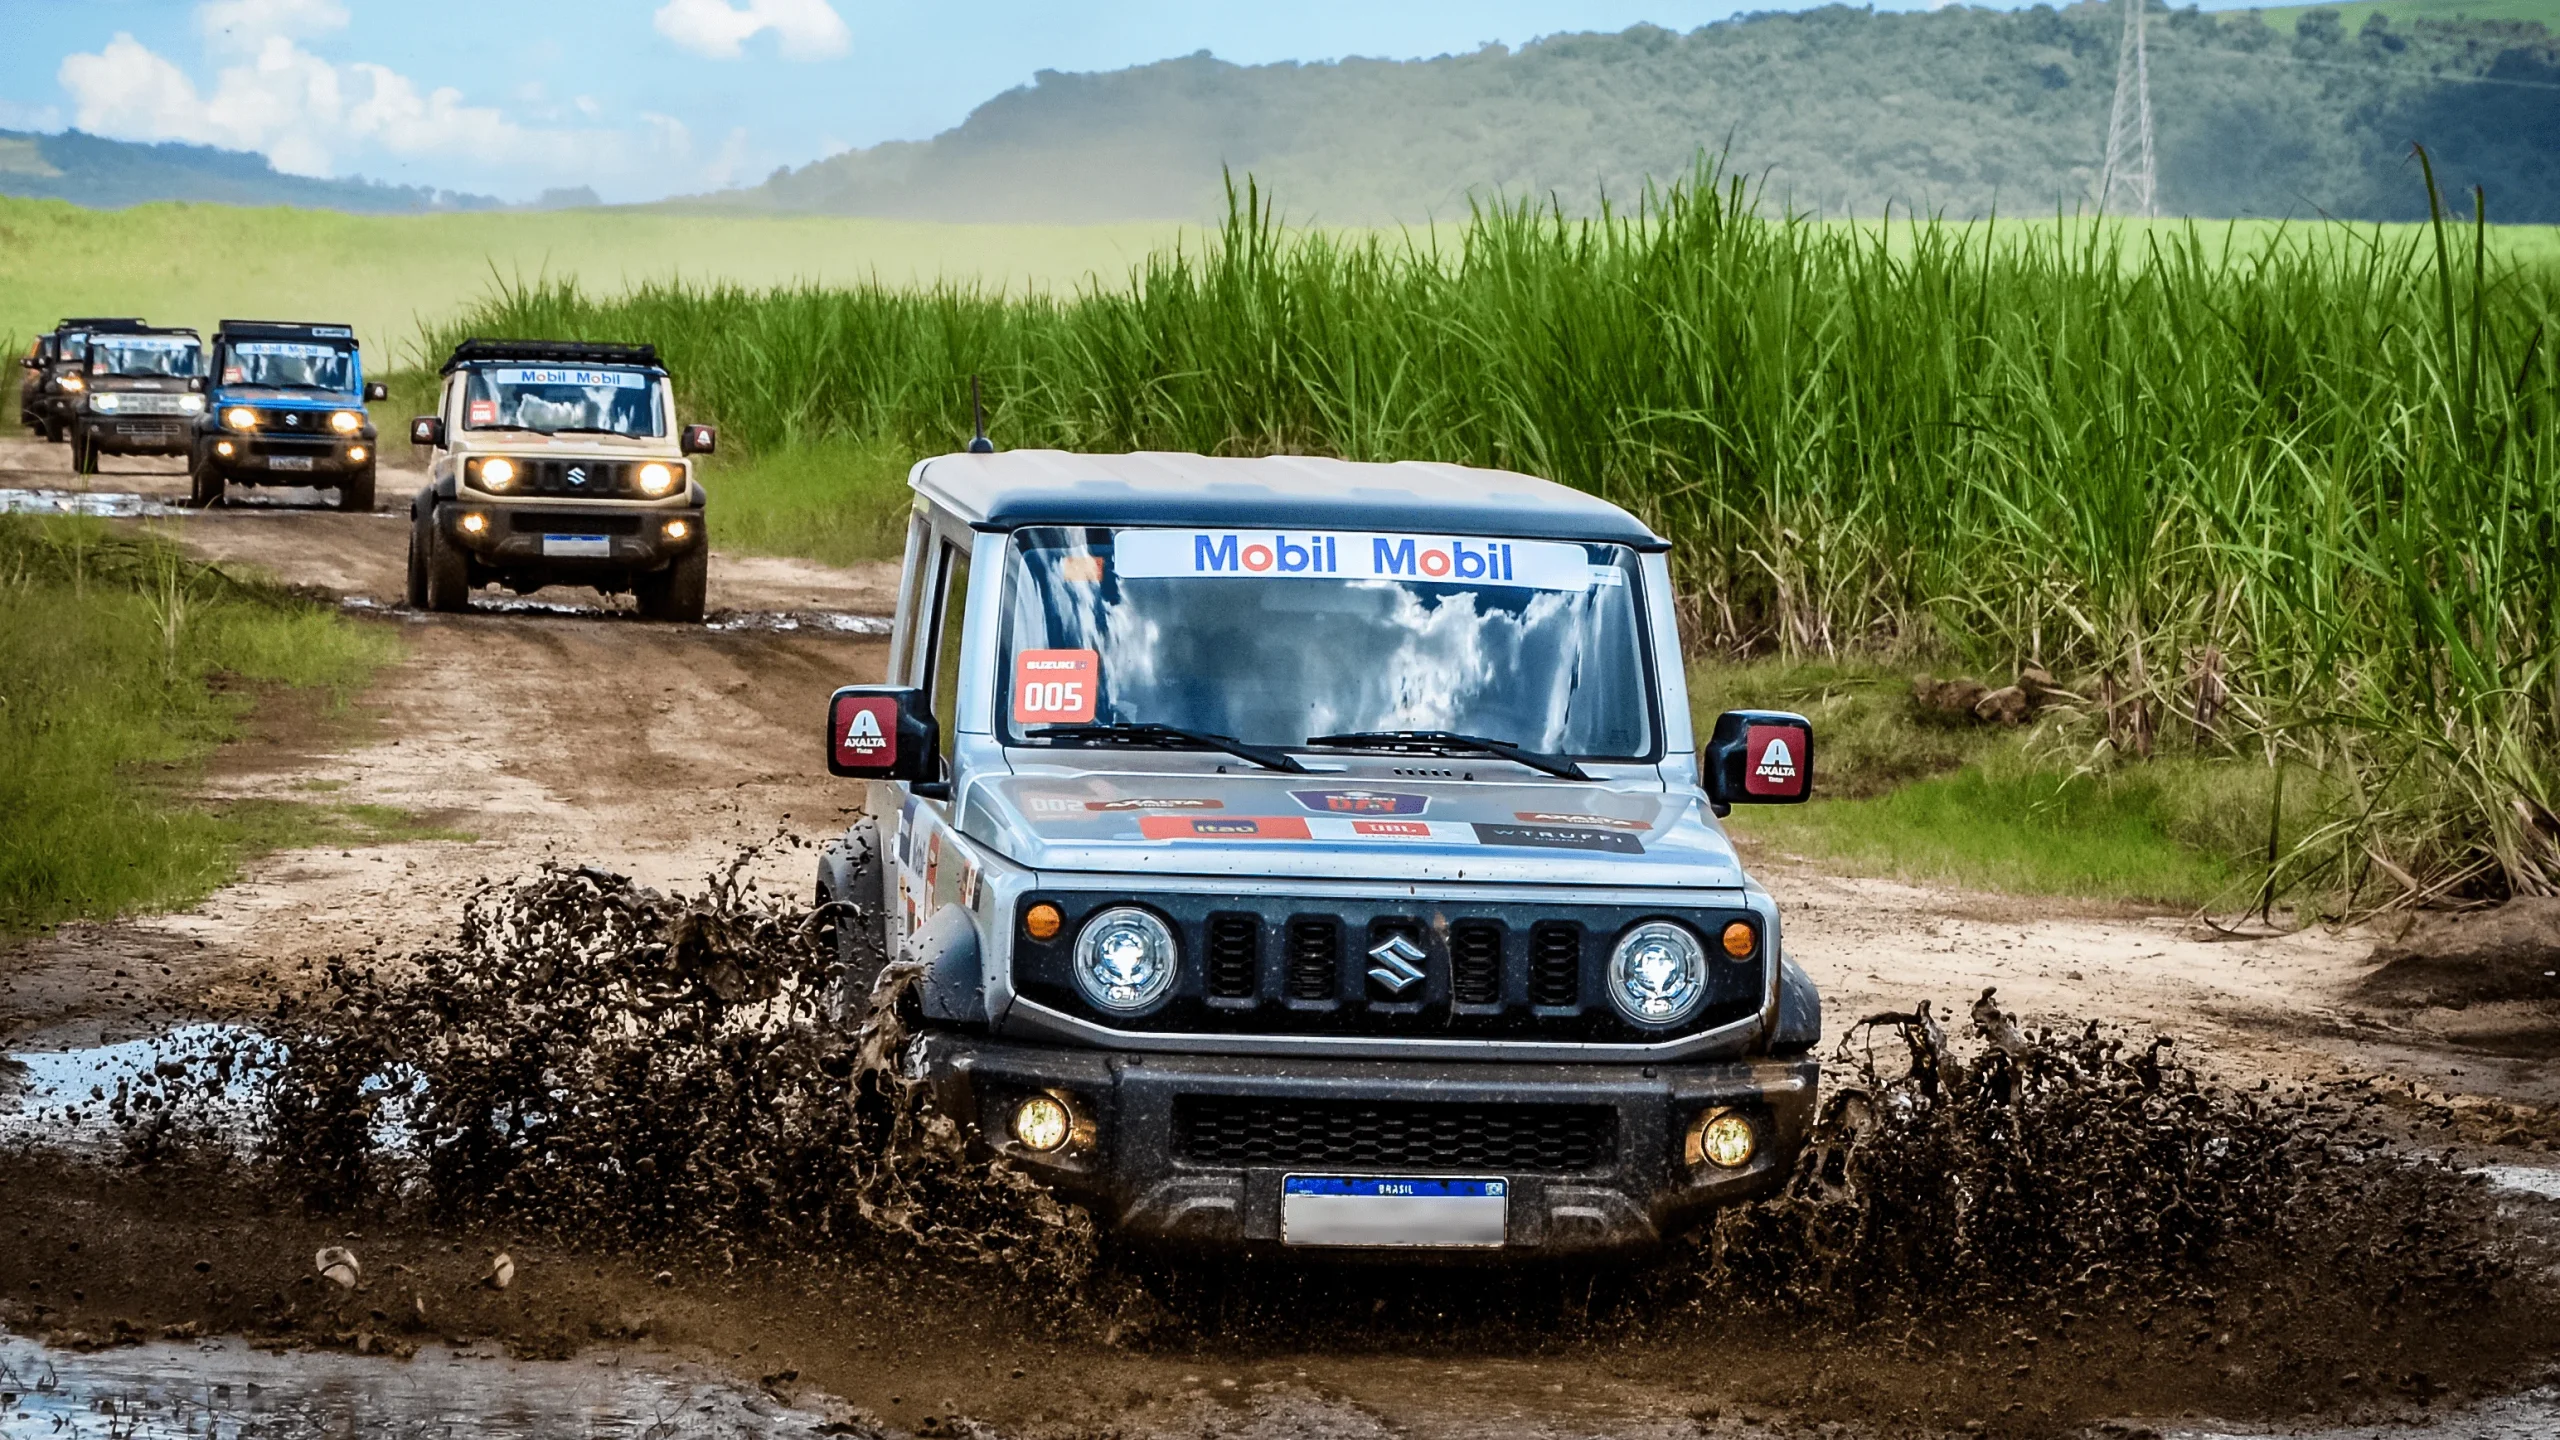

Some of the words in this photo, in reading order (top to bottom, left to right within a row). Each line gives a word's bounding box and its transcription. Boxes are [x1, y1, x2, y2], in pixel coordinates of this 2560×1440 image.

[521, 371, 566, 383] Mobil
[576, 372, 621, 385] Mobil
[1194, 534, 1337, 573] Mobil
[1372, 537, 1513, 581] Mobil
[1024, 681, 1083, 712] 005
[843, 737, 887, 748] AXALTA
[1755, 765, 1796, 777] AXALTA
[1378, 1184, 1414, 1195] BRASIL
